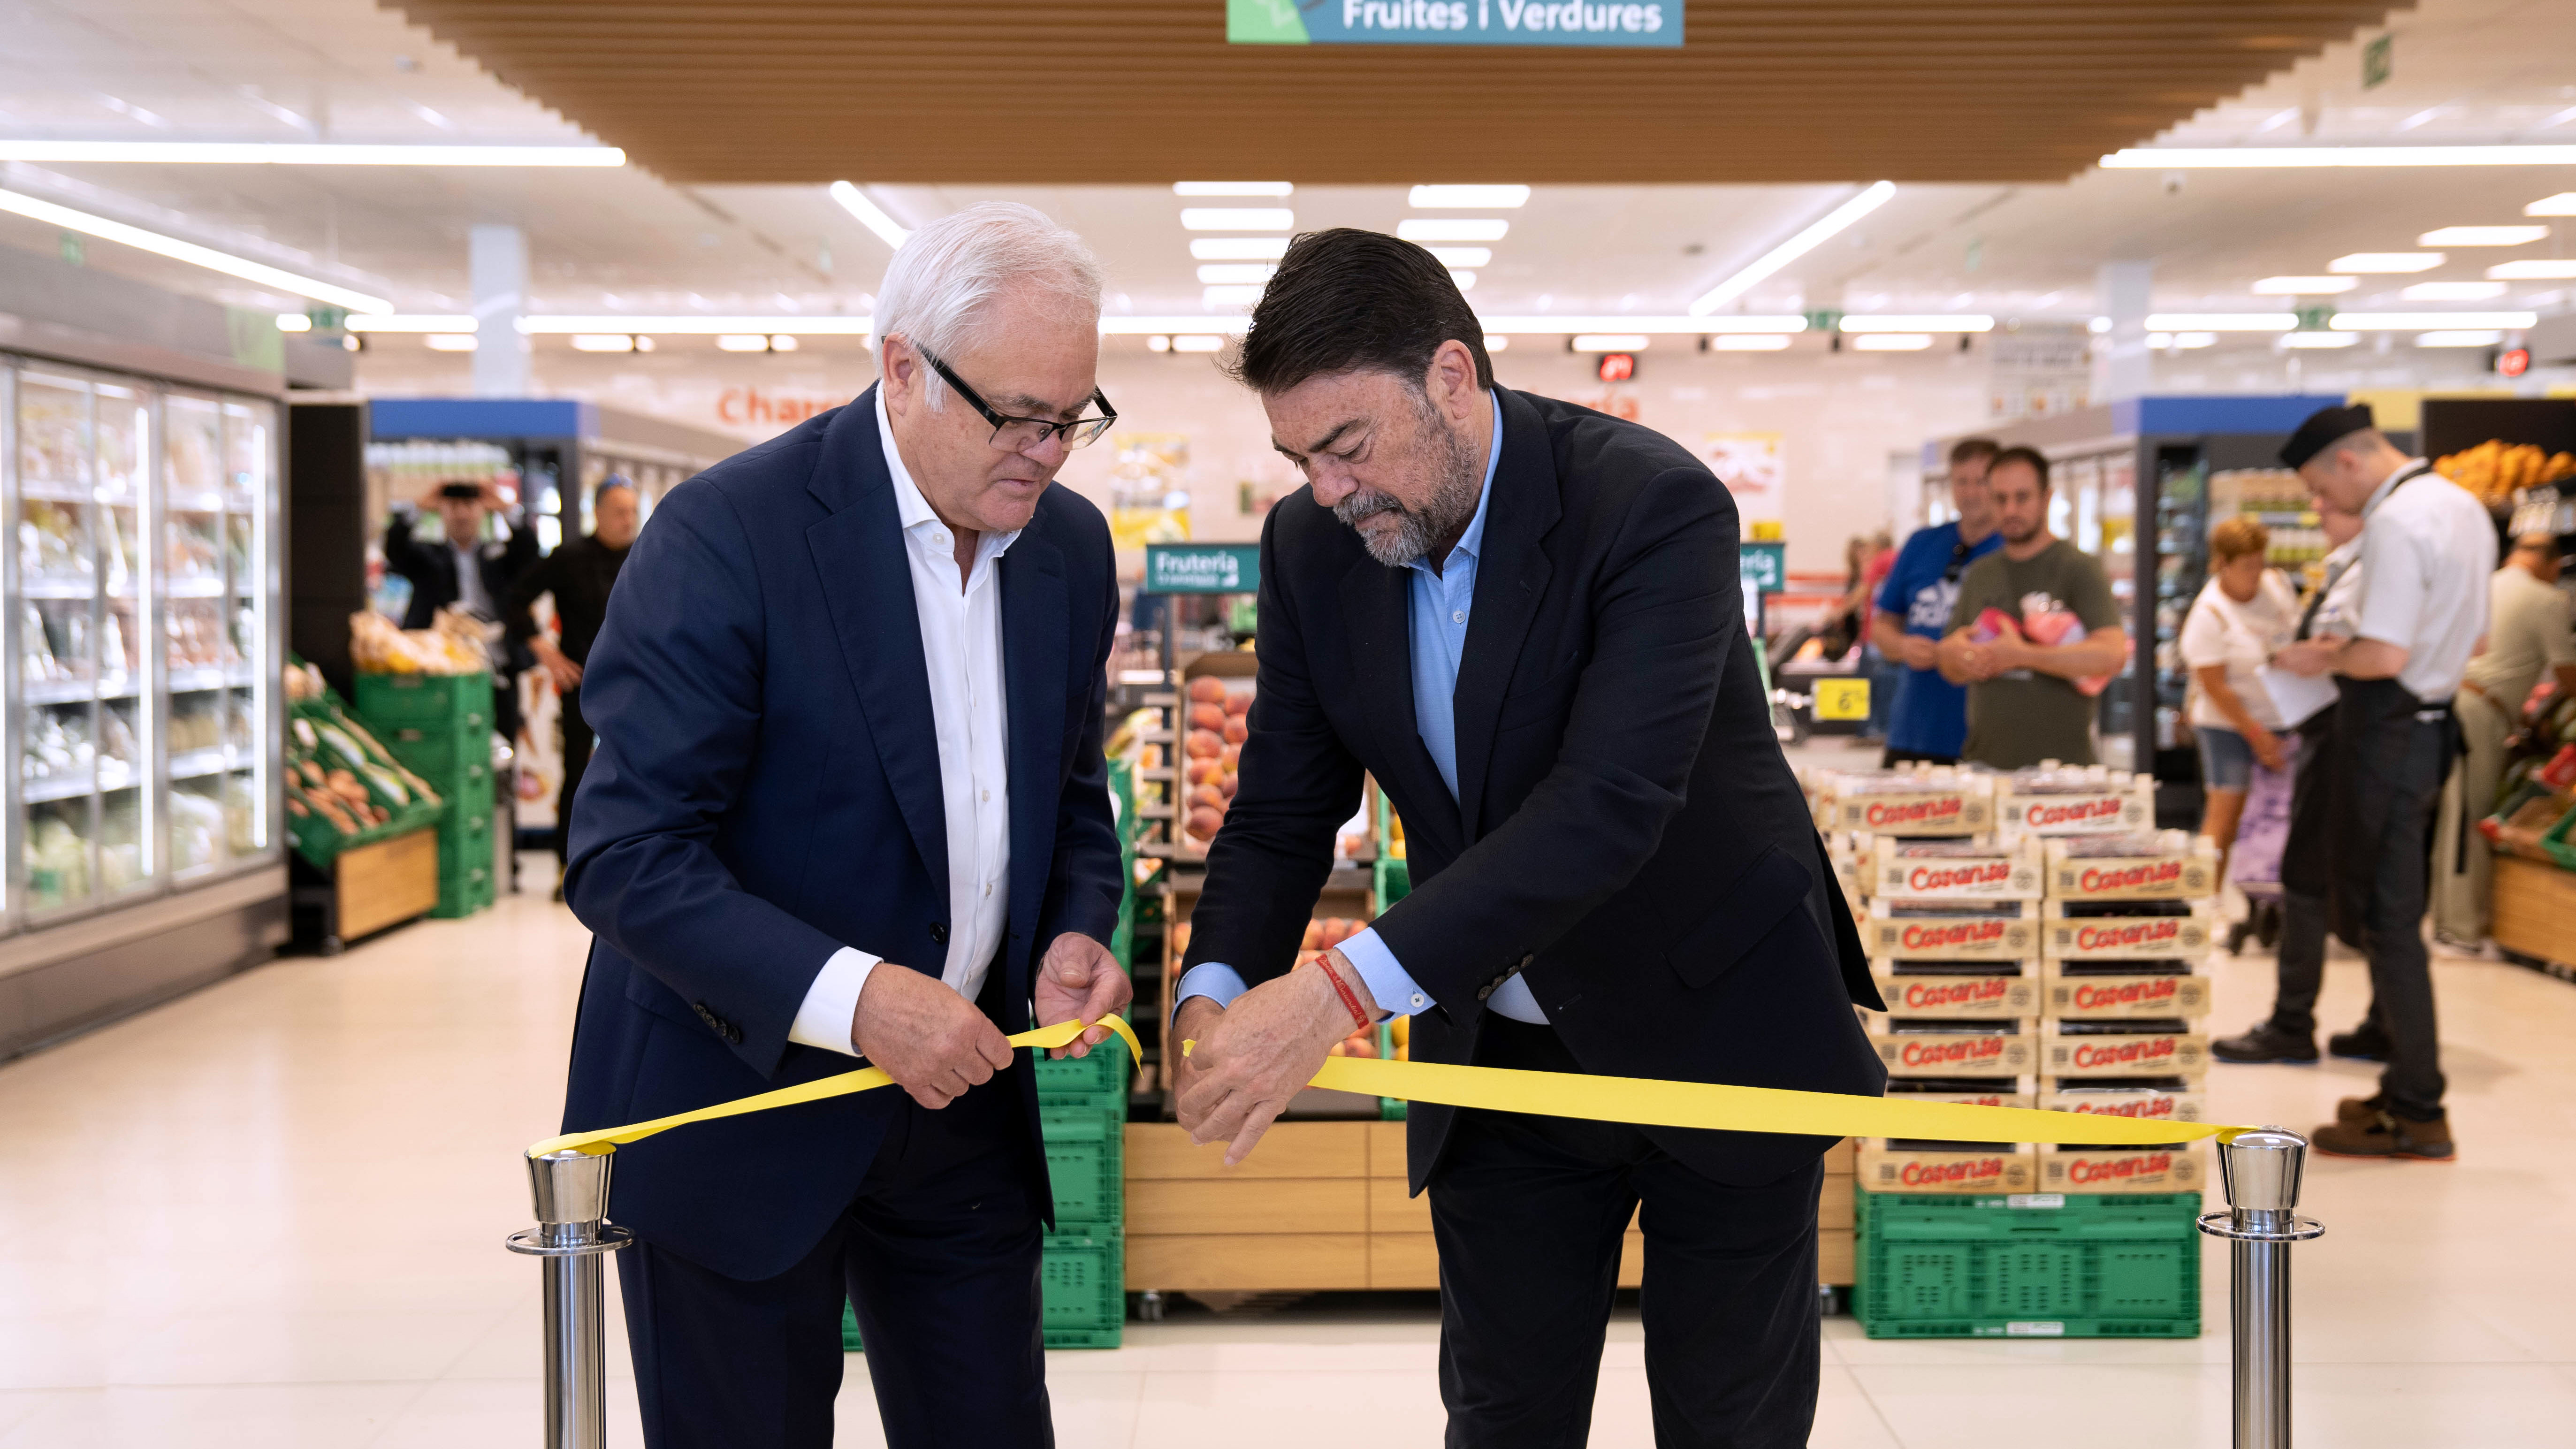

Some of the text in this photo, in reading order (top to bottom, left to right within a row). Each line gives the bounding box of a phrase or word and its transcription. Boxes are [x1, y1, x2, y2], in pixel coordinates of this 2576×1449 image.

[1343, 0, 1662, 31] Fruites i Verdures
